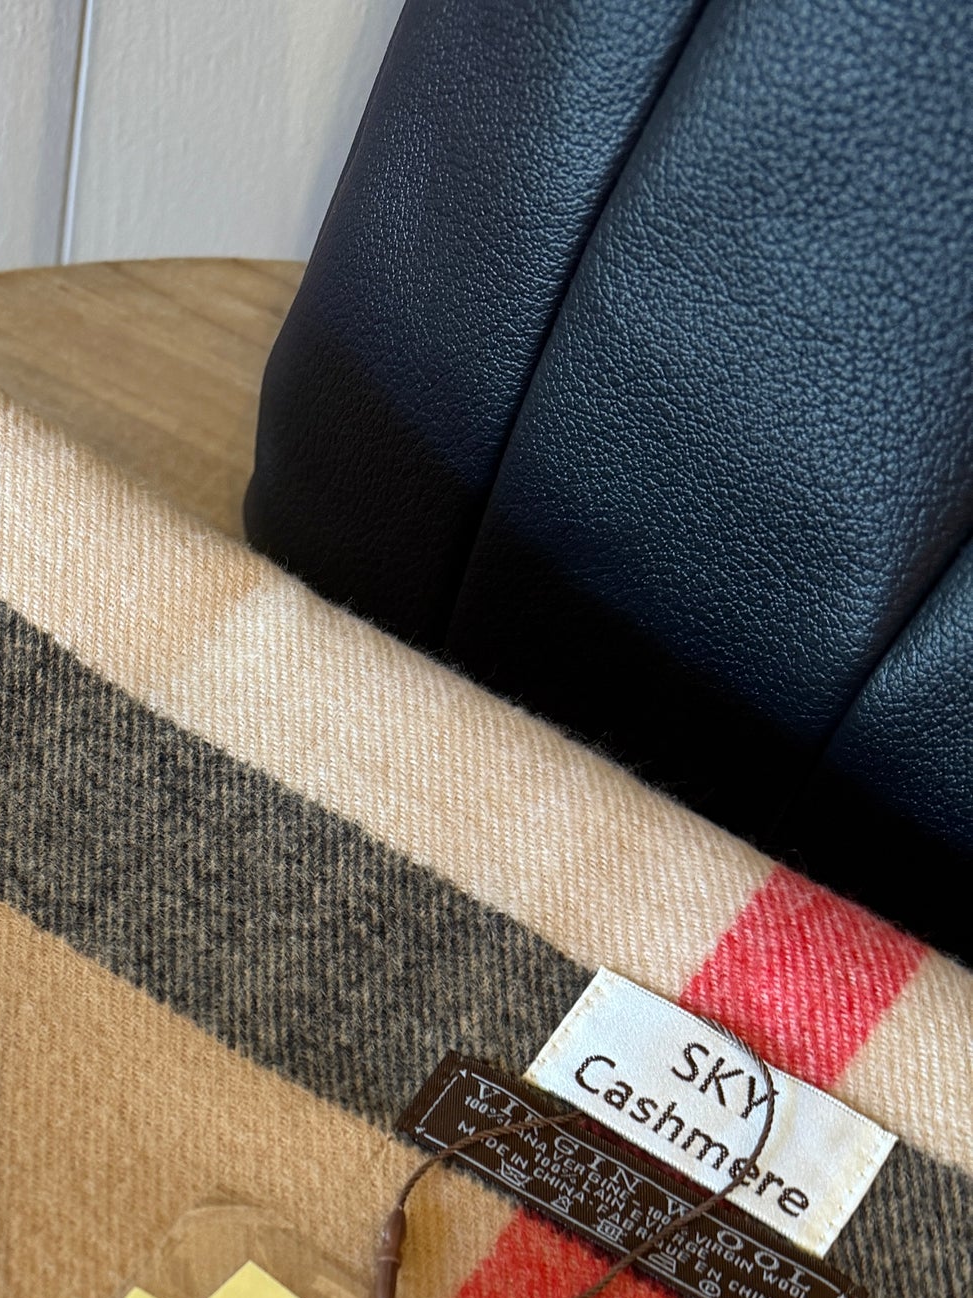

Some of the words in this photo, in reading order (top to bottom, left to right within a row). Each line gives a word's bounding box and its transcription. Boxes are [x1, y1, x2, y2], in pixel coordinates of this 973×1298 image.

[575, 1055, 809, 1217] Cashmere
[671, 1042, 778, 1119] SKY
[457, 1119, 510, 1156] MDE
[511, 1151, 529, 1171] IN
[532, 1166, 586, 1206] CHINA
[694, 1260, 723, 1283] EN
[694, 1231, 754, 1275] VIRGIN
